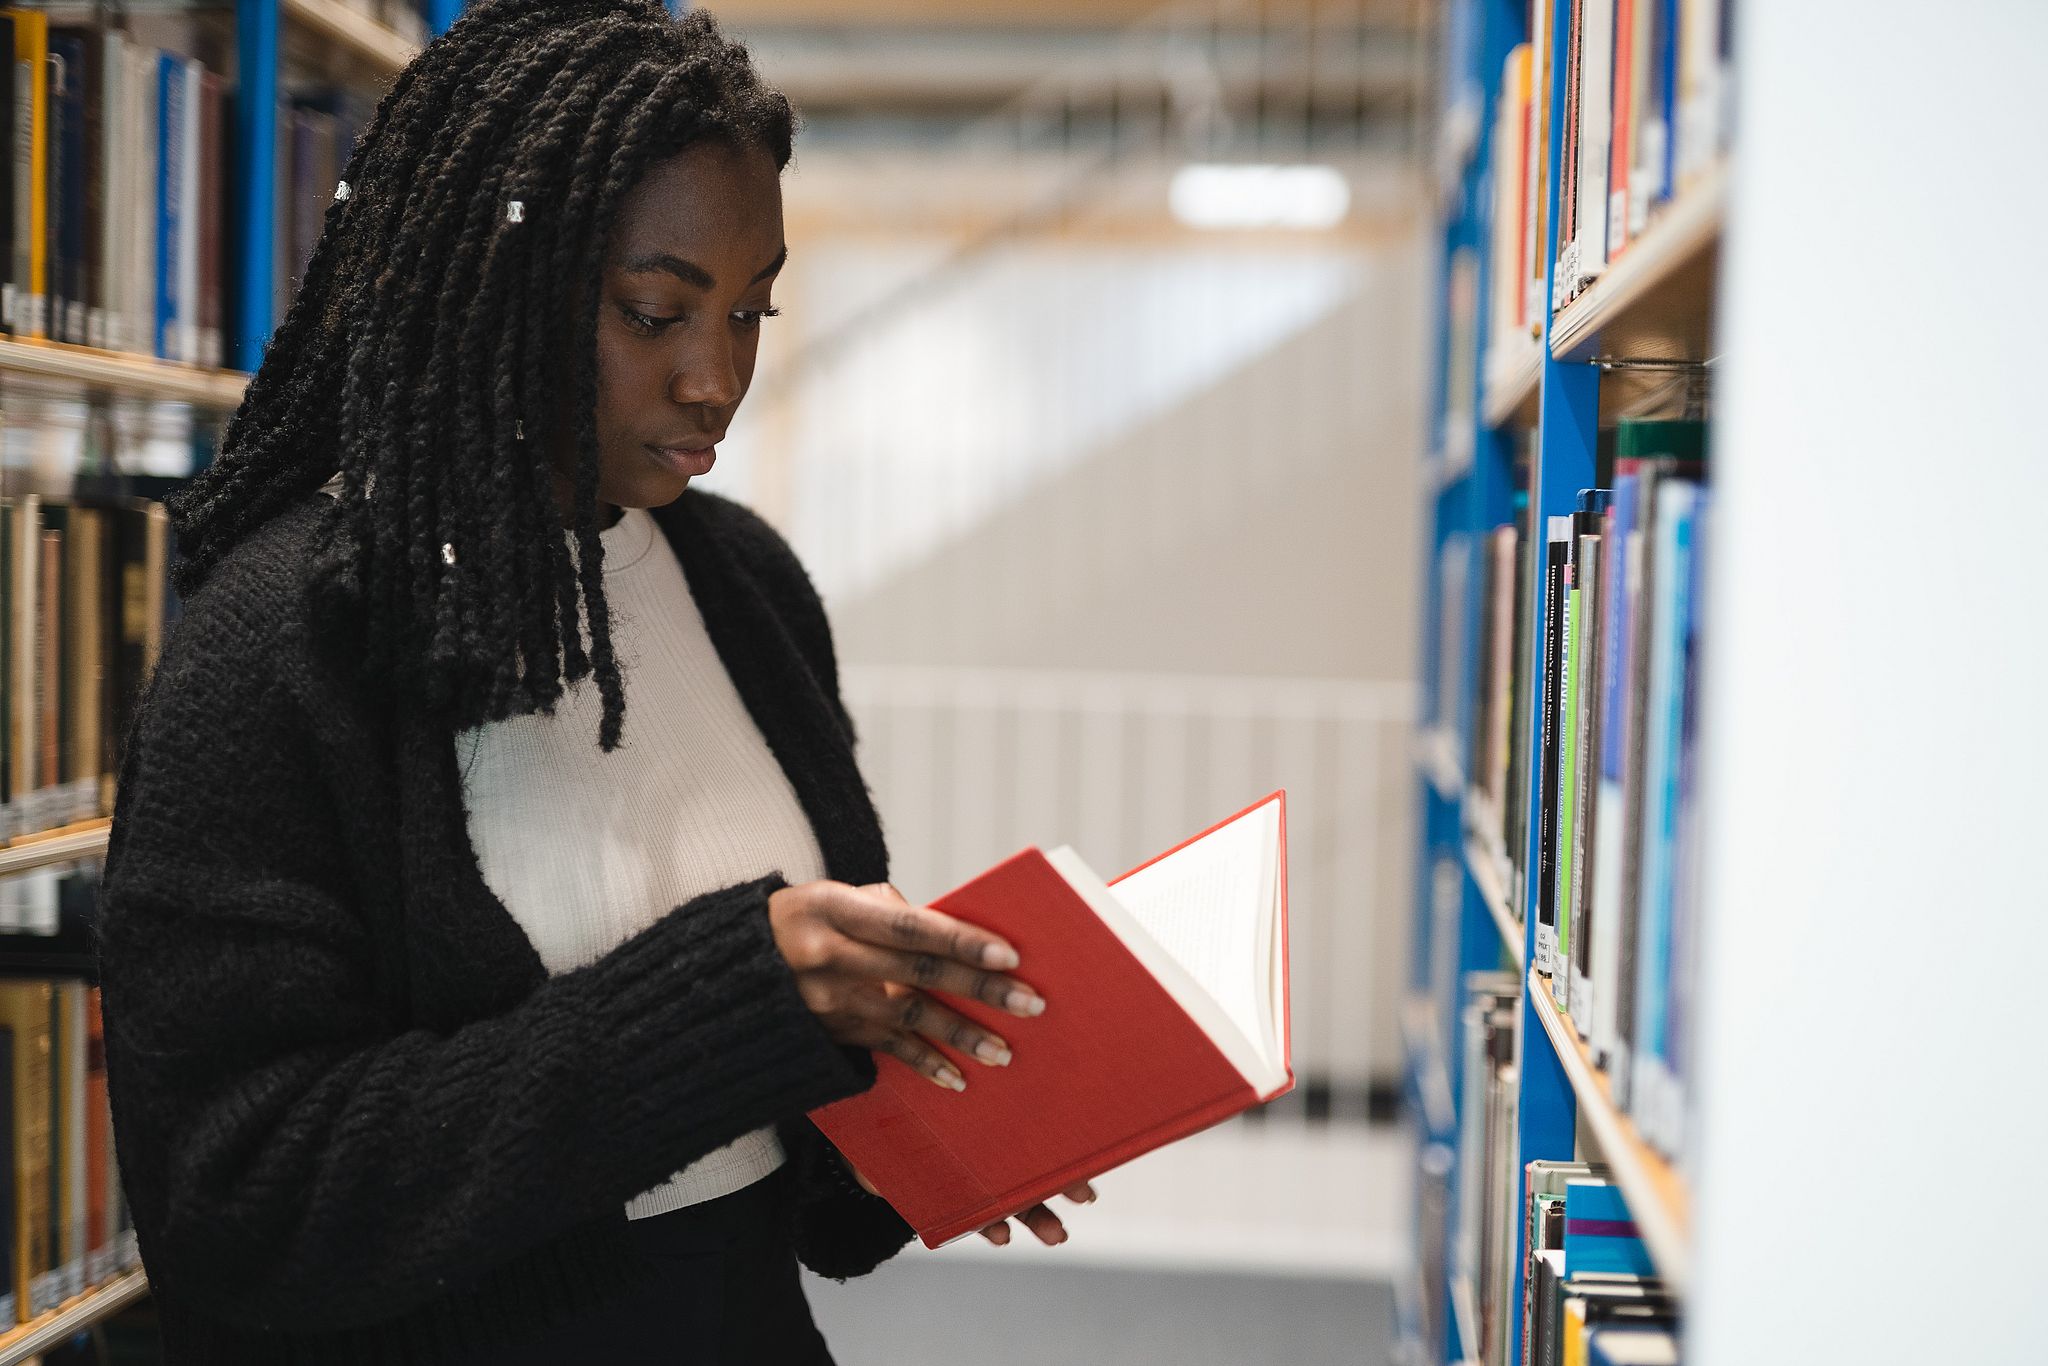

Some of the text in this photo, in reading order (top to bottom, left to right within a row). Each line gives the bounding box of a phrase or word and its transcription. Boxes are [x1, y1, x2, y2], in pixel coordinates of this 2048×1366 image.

[1549, 565, 1557, 627] Interpreting
[1562, 600, 1570, 653] HONG
[1560, 660, 1568, 711] KONG
[1577, 708, 1590, 918] Multicultural Japan
